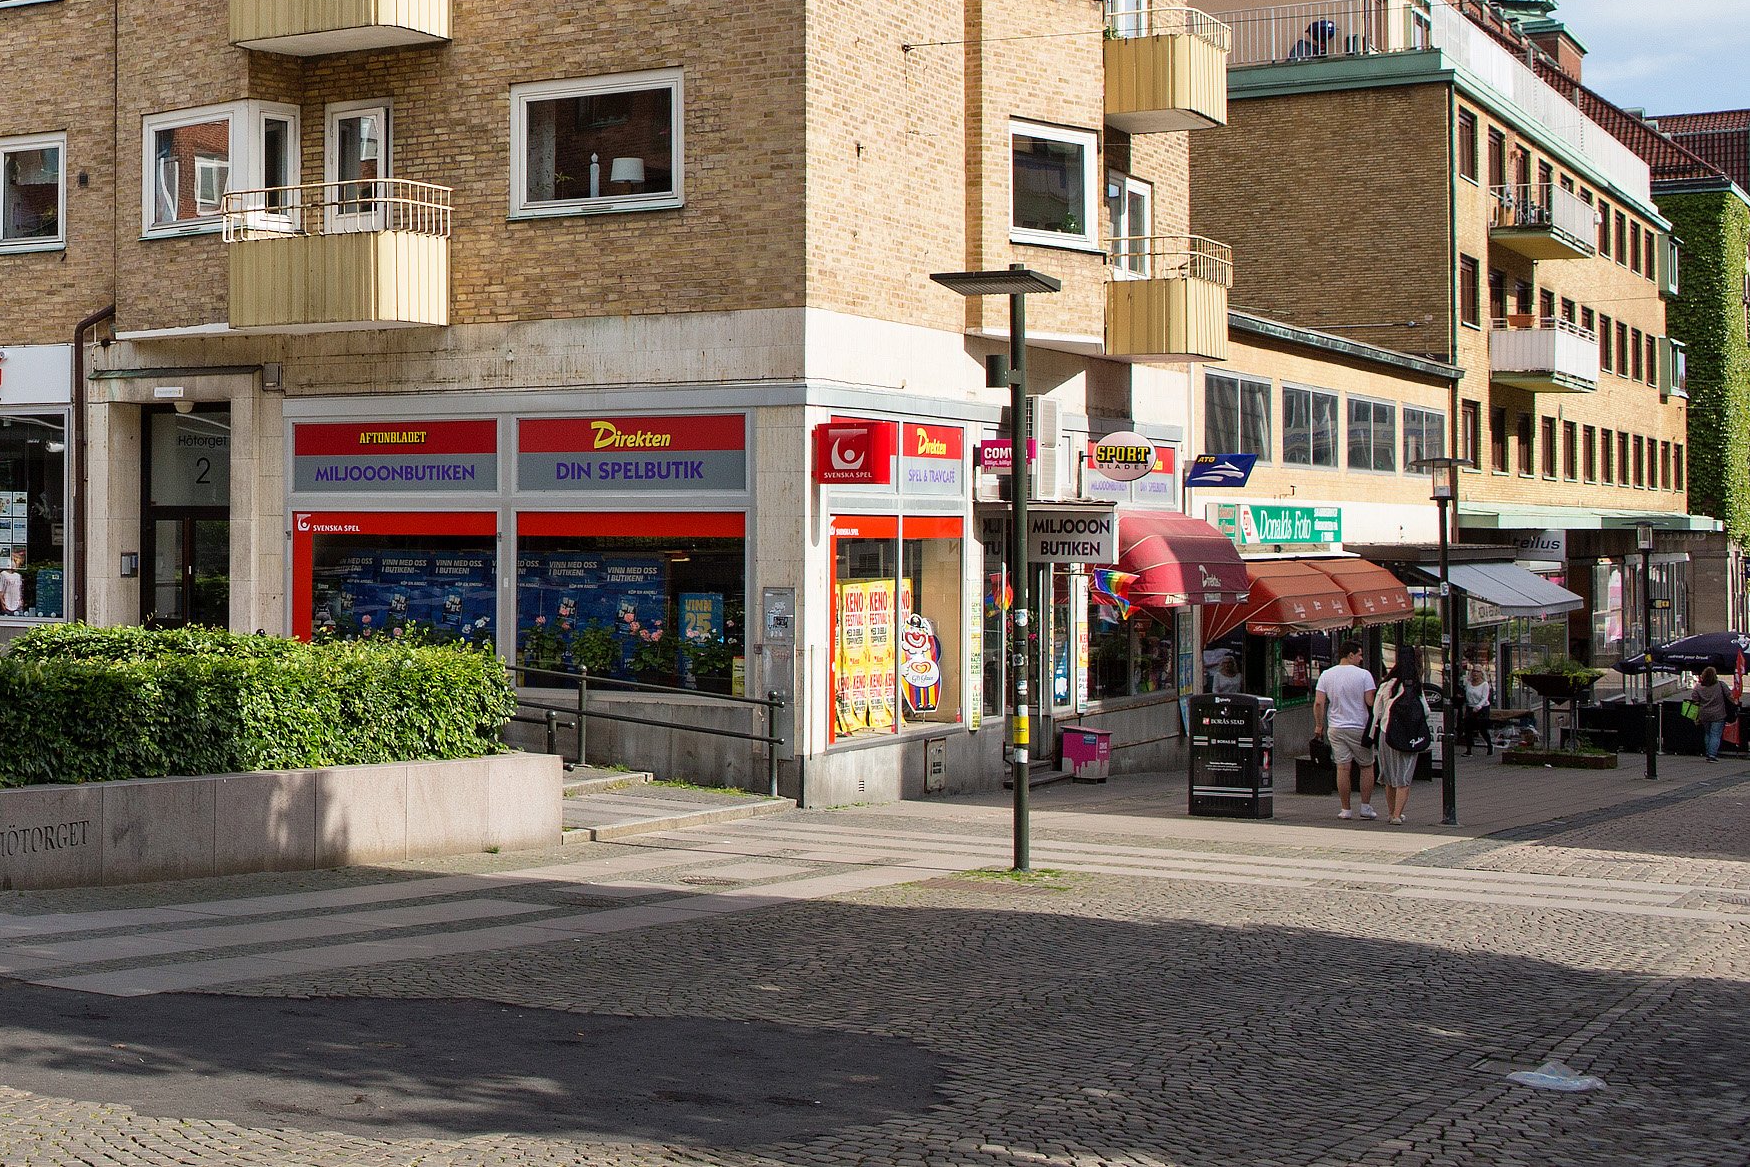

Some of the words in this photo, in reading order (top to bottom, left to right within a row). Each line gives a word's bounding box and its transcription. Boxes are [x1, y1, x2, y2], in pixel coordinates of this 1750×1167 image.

[178, 435, 227, 448] Hötorget
[359, 431, 427, 444] AFTONBLADET
[591, 421, 671, 449] Direkten
[917, 428, 946, 455] Direkten
[1096, 446, 1150, 463] SPORT
[196, 457, 210, 484] 2
[315, 464, 475, 482] MILJOOONBUTIKEN
[556, 462, 592, 480] DIN
[599, 461, 704, 480] SPELBUTIK
[909, 469, 922, 482] SPEL
[924, 470, 928, 482] &
[930, 468, 955, 483] TRAVCAFÉ
[1033, 519, 1110, 534] MILJOOON
[1260, 510, 1292, 540] Donalds
[1294, 511, 1311, 539] Foto
[1041, 541, 1100, 556] BUTIKEN
[685, 599, 712, 612] VINN
[845, 592, 863, 612] KENO
[870, 591, 887, 611] KENO
[685, 613, 712, 635] 25
[845, 614, 863, 626] FESTIVAL
[870, 612, 887, 625] FESTIVAL
